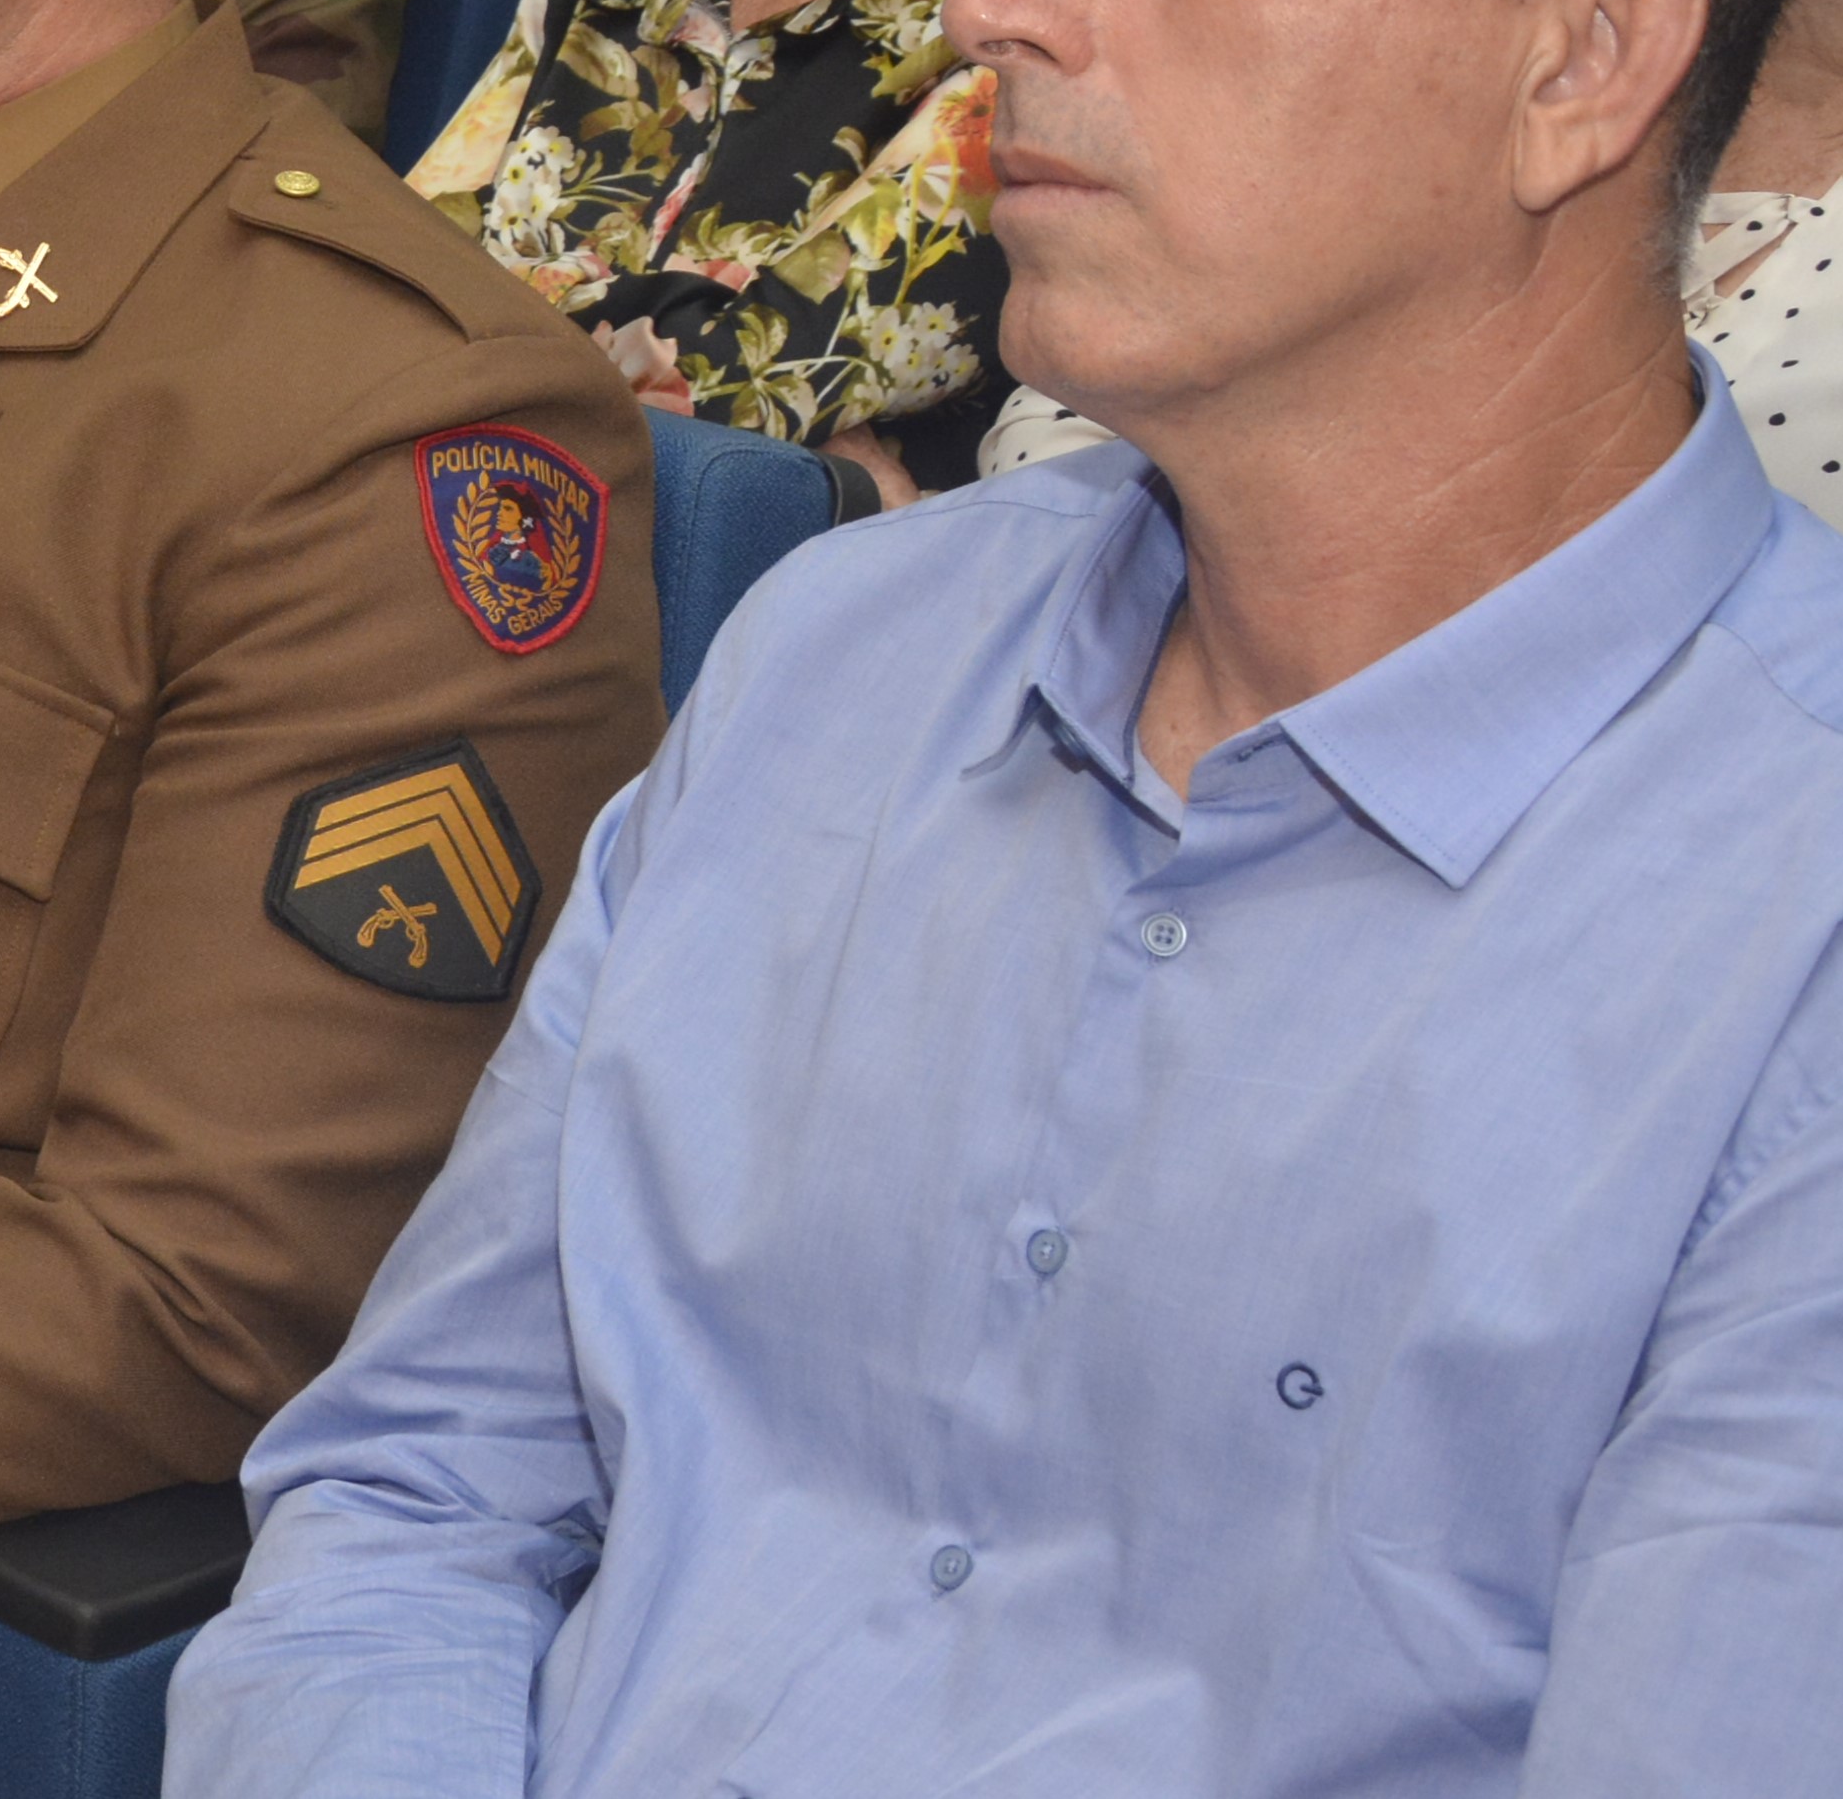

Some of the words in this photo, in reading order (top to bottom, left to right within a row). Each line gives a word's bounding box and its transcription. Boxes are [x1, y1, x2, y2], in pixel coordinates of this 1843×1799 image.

[431, 440, 521, 479] POLÍCIA
[522, 452, 591, 523] MILITAR
[461, 570, 507, 625] MINAS
[507, 595, 564, 636] GERAIS
